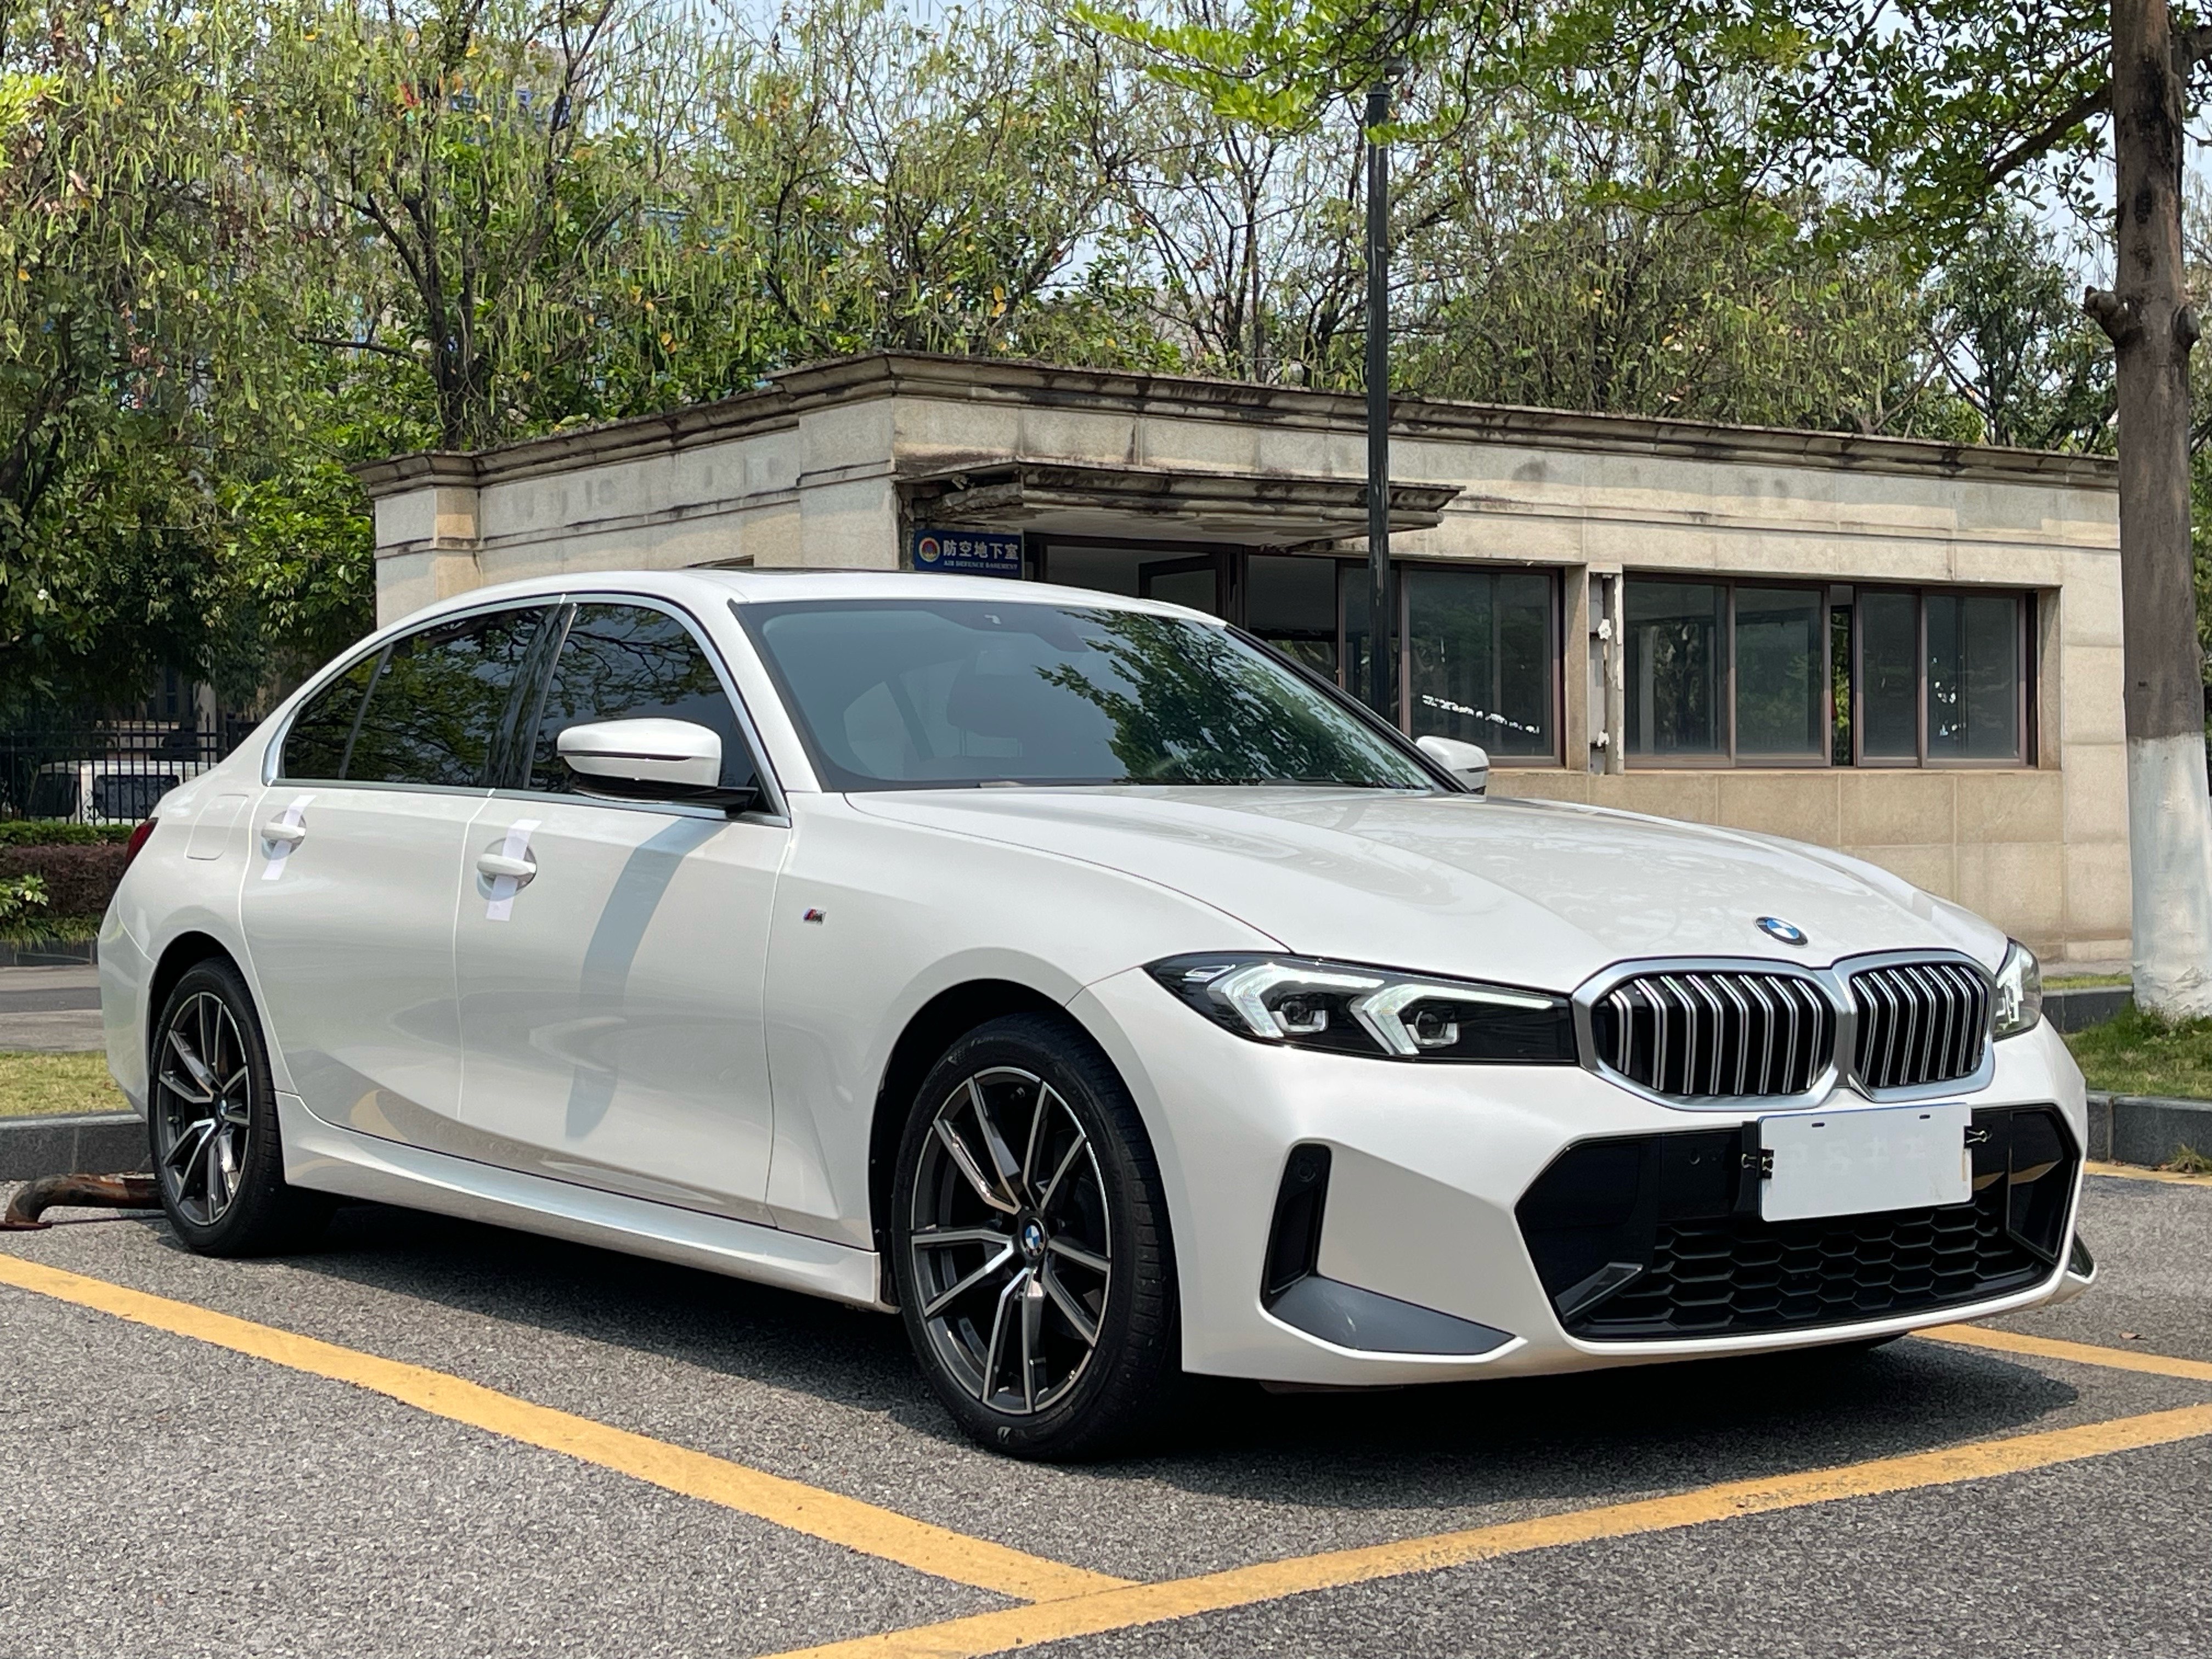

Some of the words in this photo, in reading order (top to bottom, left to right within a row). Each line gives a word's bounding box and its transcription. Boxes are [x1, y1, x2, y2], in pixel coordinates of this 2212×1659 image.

[943, 539, 1019, 560] 防空地下室
